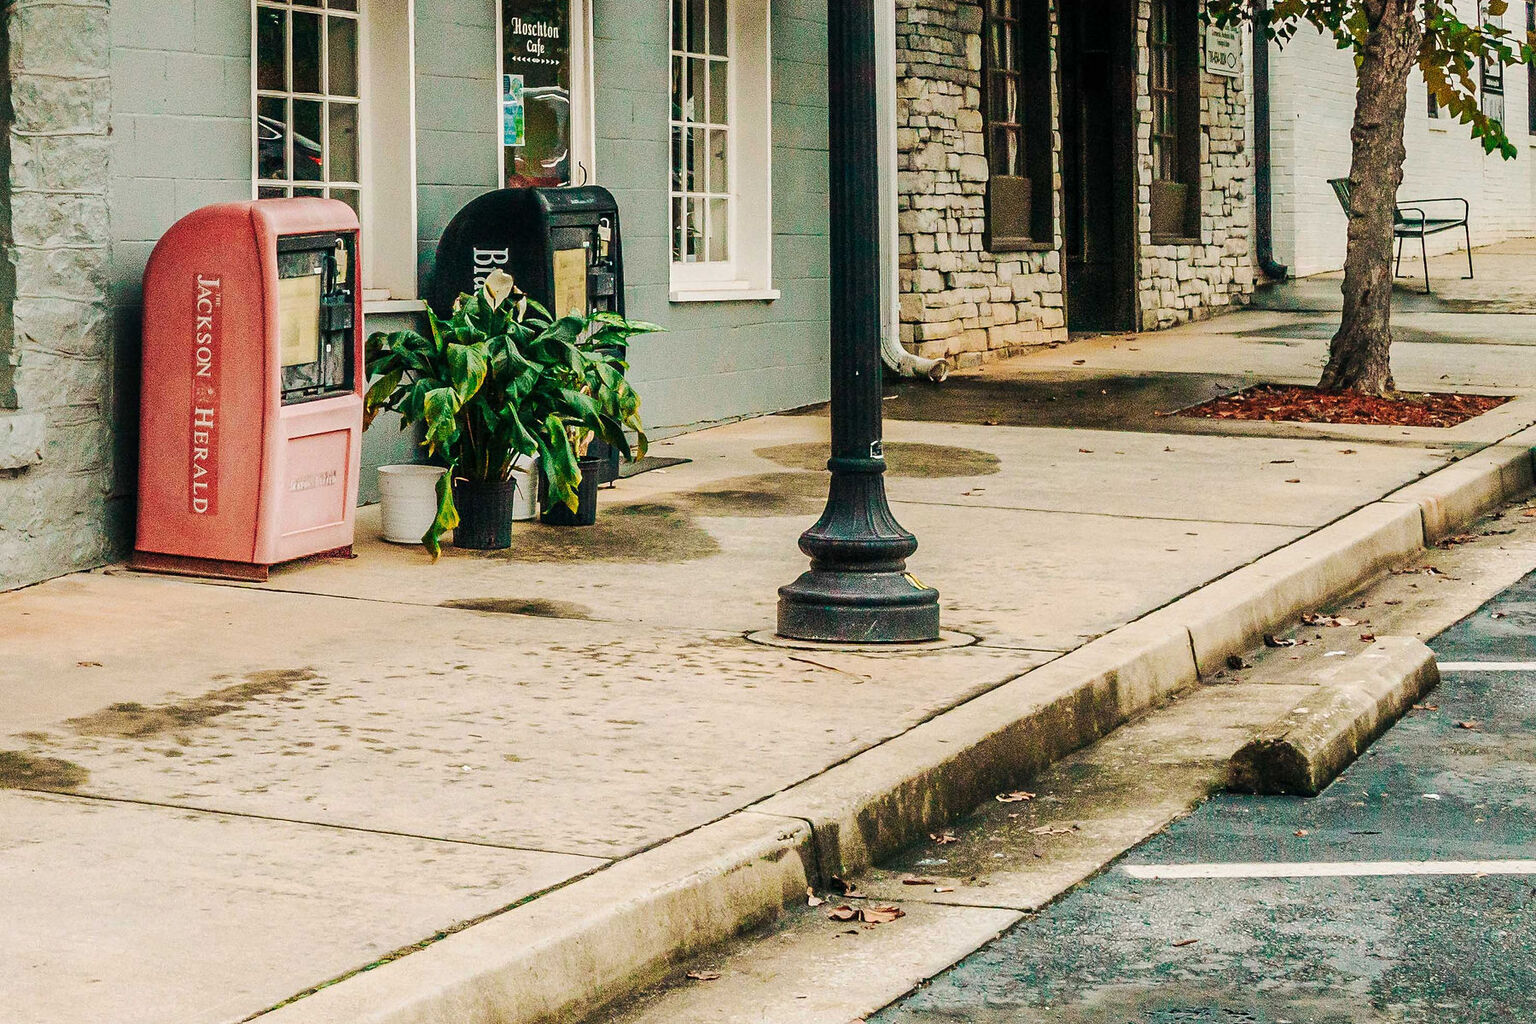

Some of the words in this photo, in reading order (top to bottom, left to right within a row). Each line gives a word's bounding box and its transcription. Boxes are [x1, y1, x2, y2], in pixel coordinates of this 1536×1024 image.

[511, 17, 560, 39] Hoschton
[526, 38, 545, 56] Cafe
[473, 247, 509, 297] Bla
[196, 274, 221, 377] JACKSON
[193, 406, 215, 514] HERALD
